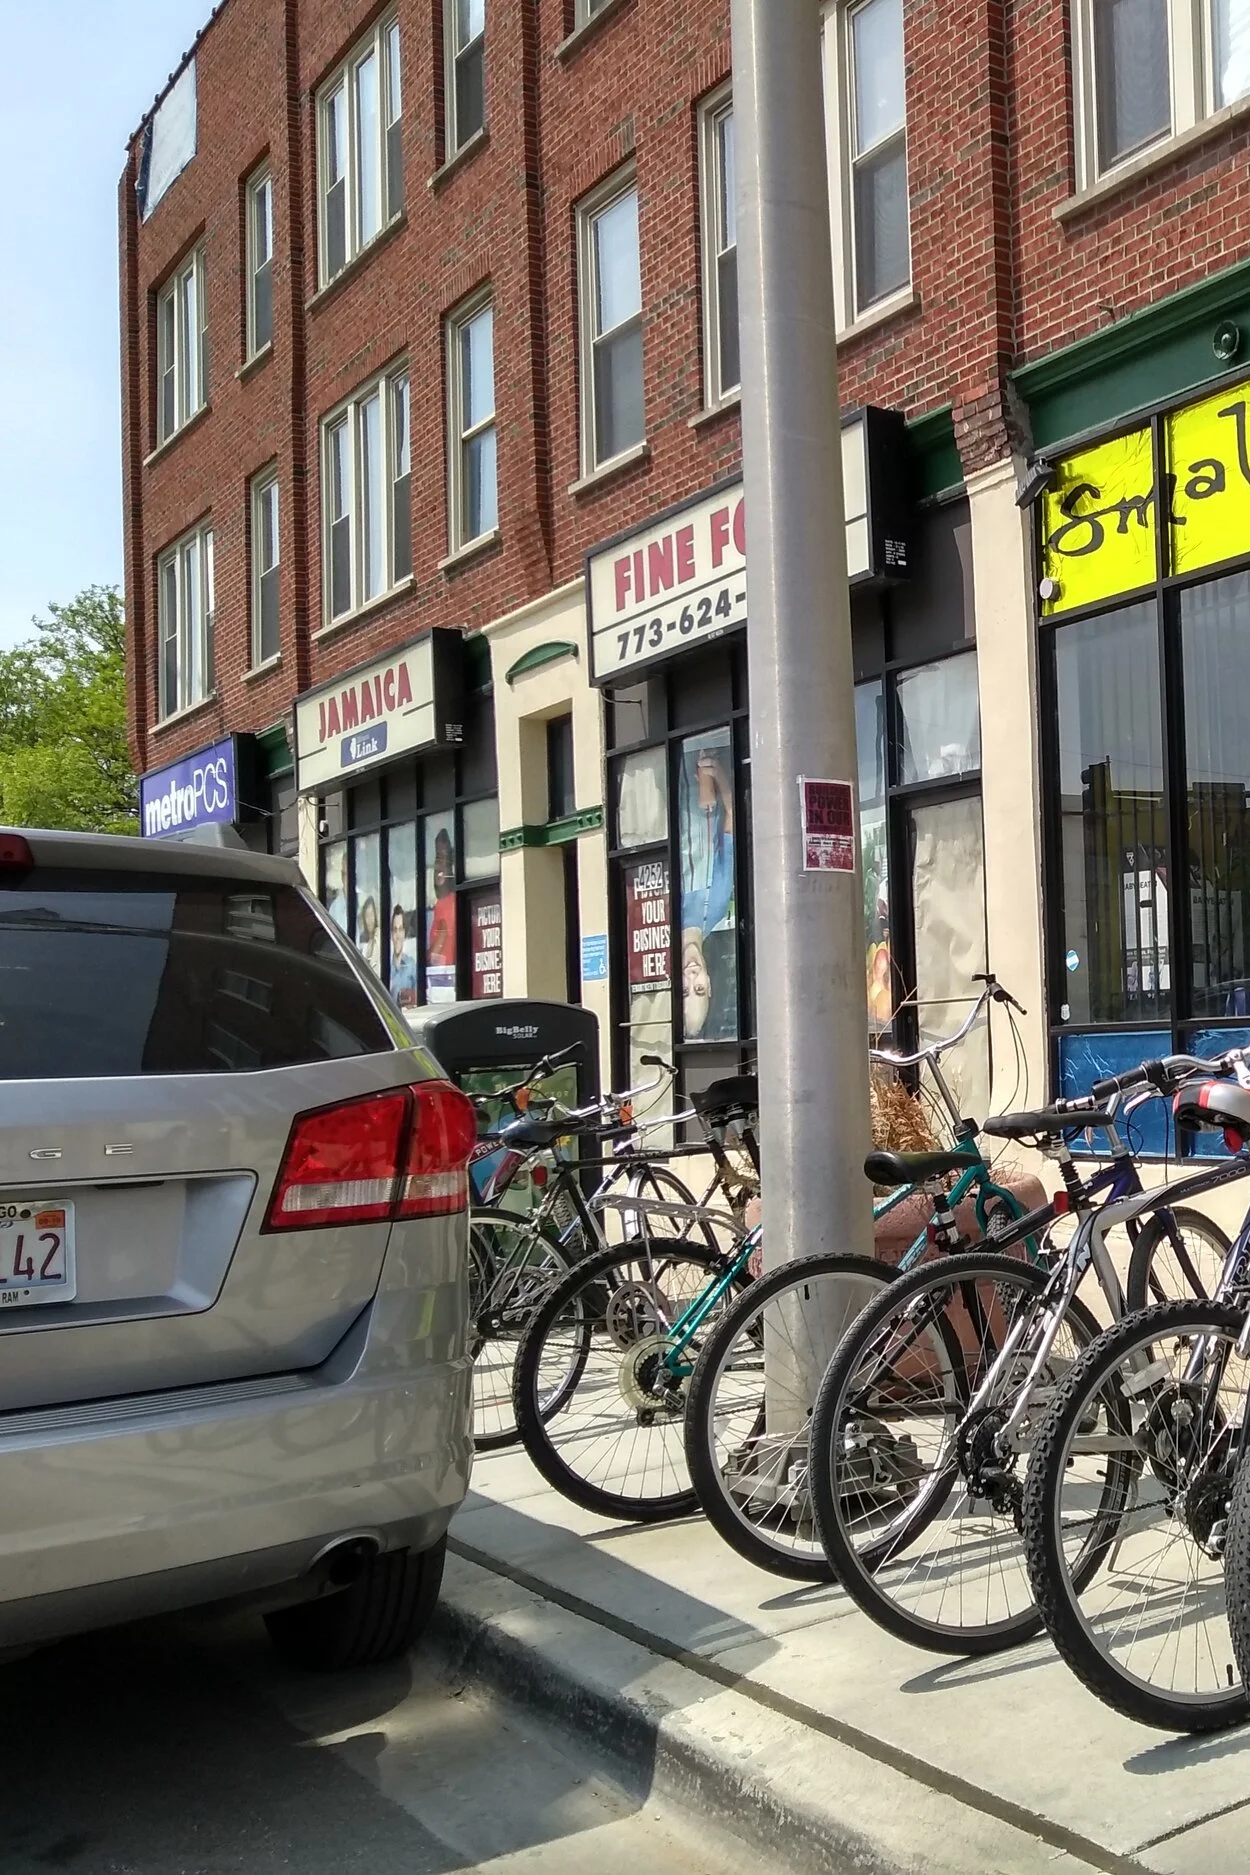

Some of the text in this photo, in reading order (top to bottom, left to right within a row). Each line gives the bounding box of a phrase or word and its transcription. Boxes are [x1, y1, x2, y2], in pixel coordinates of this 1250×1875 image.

[614, 524, 695, 612] FINE
[319, 662, 413, 744] JAMAICA
[356, 737, 378, 758] Link
[146, 757, 228, 836] metroPCS
[638, 863, 662, 889] 4252
[642, 900, 665, 924] YOUR
[633, 925, 670, 952] BUSINES
[642, 952, 666, 977] HERE
[496, 1026, 538, 1035] BigBelly
[0, 1232, 62, 1284] 42
[2, 1291, 19, 1304] RAM
